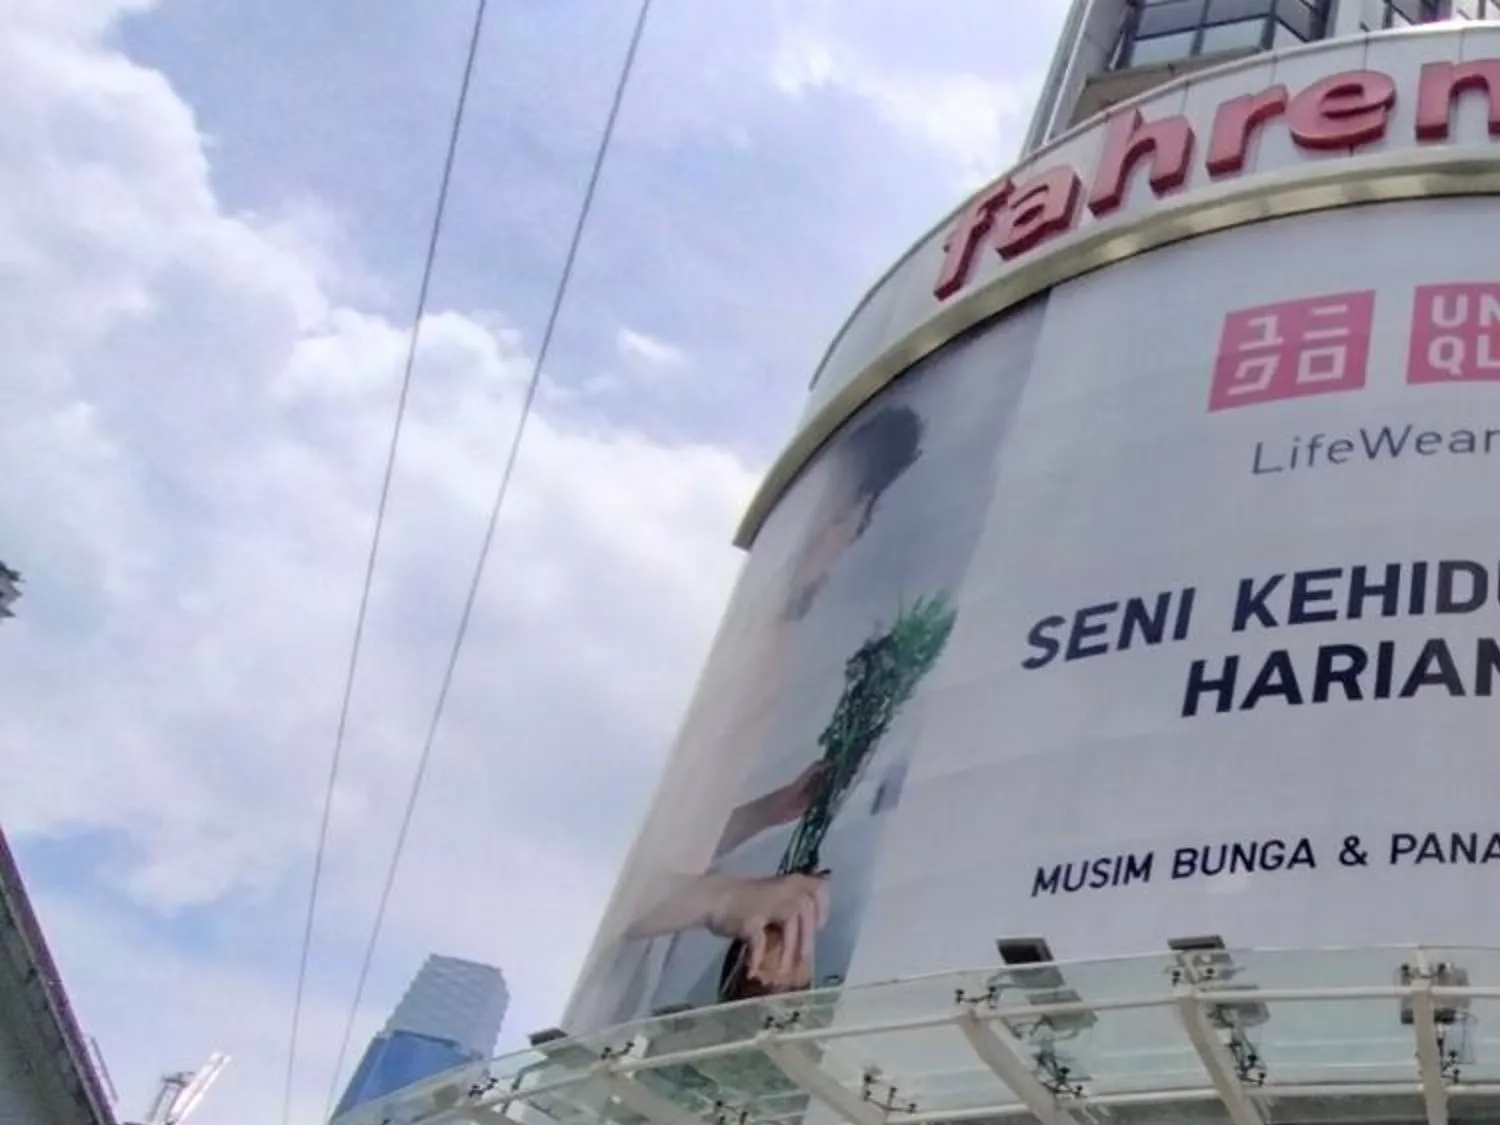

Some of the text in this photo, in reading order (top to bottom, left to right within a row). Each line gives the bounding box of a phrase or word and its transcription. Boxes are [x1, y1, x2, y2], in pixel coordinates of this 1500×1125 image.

[1020, 586, 1197, 671] SENI
[1031, 852, 1154, 898] MUSIM
[1171, 836, 1318, 880] BUNGA
[1338, 835, 1370, 867] &
